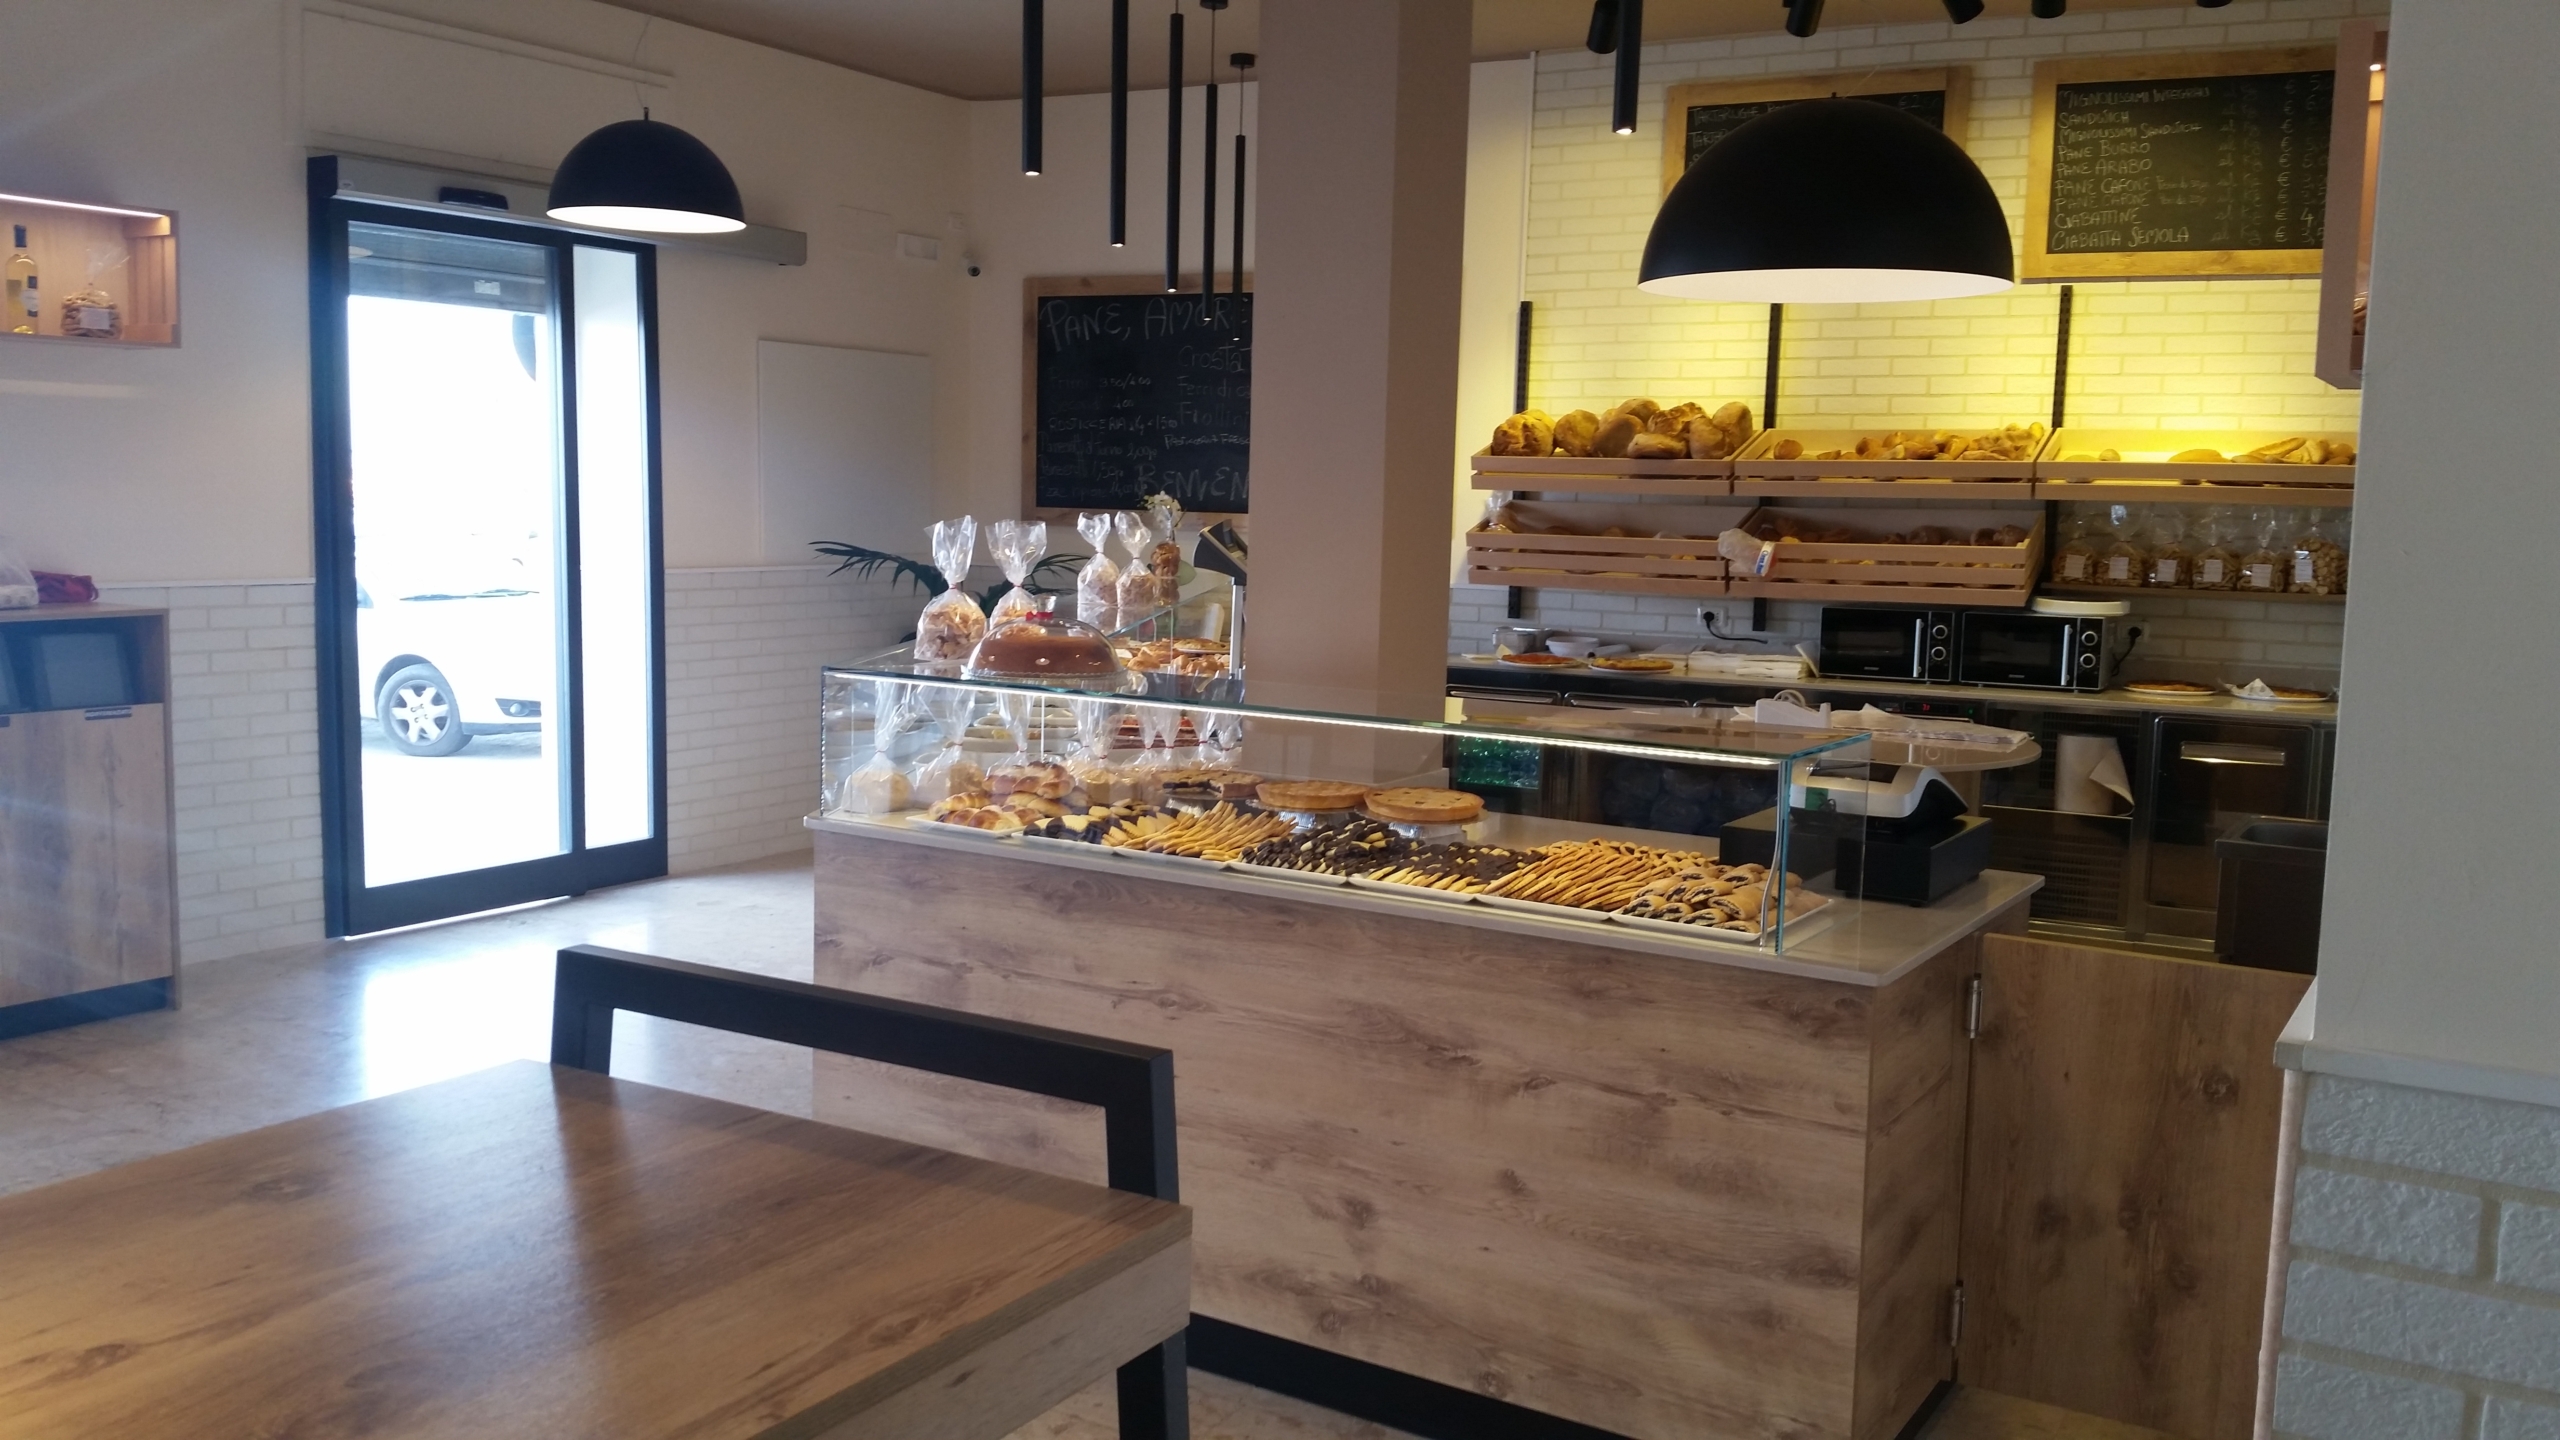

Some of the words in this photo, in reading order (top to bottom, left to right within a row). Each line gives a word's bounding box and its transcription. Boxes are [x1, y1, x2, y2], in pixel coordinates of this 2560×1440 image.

[2058, 109, 2129, 129] SANDWICH
[2057, 145, 2093, 162] PANE
[2099, 139, 2150, 157] BURRO
[2056, 162, 2092, 178] PANE
[2095, 158, 2152, 176] ARABO
[2055, 178, 2096, 197] PANE
[2054, 195, 2098, 213] PANE
[2054, 207, 2142, 229] CIABATTINE
[2051, 230, 2122, 251] CIABATTA
[2128, 226, 2190, 248] SEMOLA
[2274, 225, 2288, 243] €
[1038, 299, 1131, 352] PANE,
